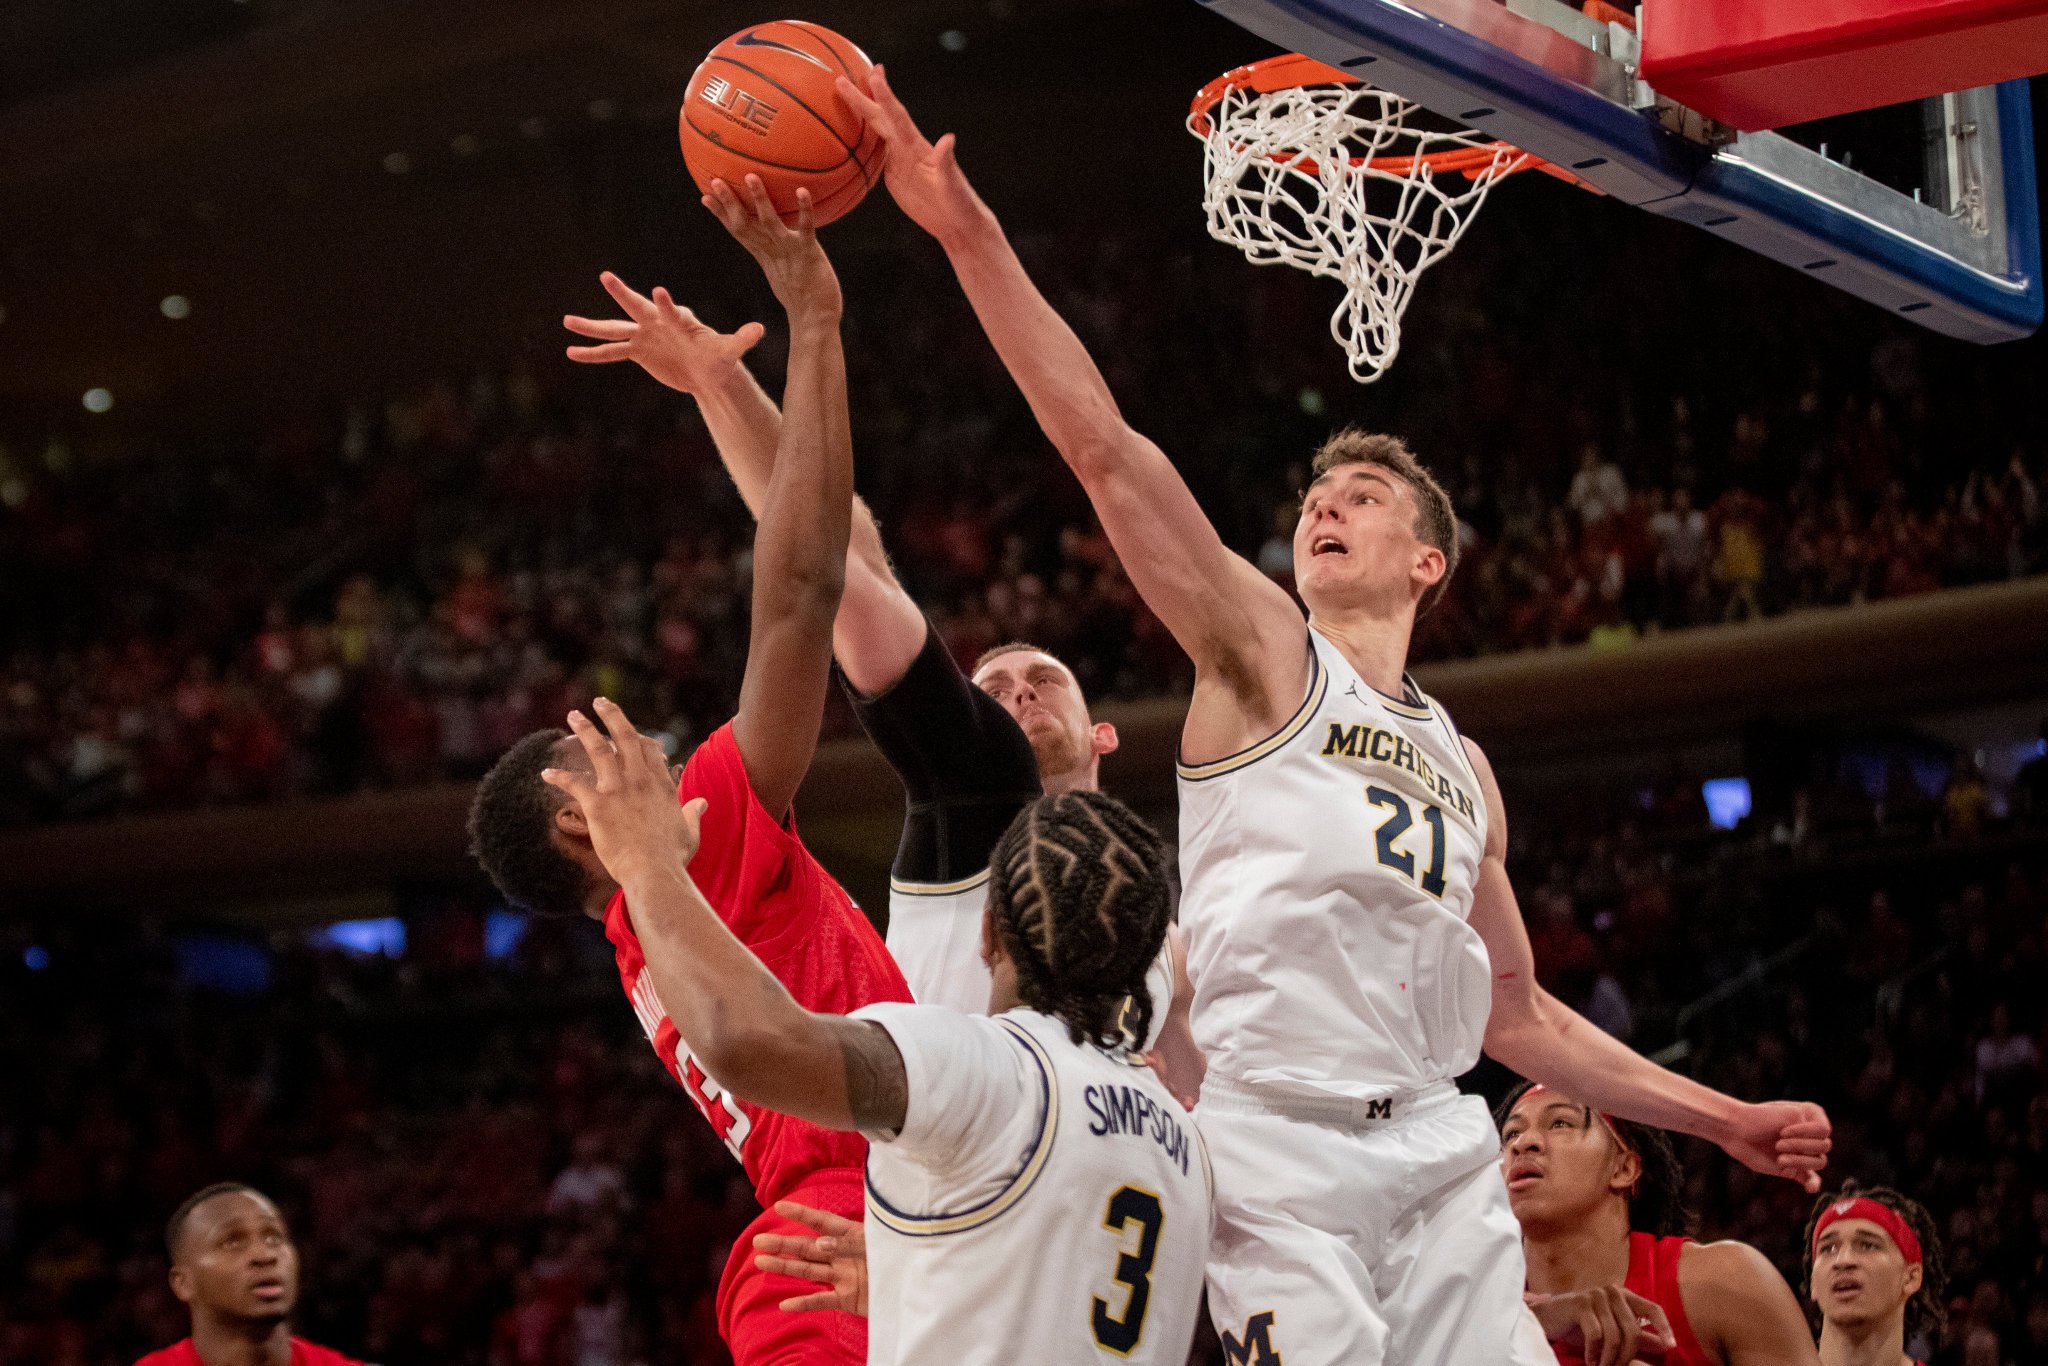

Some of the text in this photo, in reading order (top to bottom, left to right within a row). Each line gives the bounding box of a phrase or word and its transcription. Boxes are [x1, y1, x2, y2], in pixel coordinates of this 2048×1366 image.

[701, 75, 779, 131] ELITE
[1322, 722, 1477, 828] MICHIGAN
[1365, 784, 1447, 898] 21
[1084, 1084, 1189, 1177] SIMPSON
[1366, 1098, 1393, 1119] M
[1089, 1184, 1164, 1358] 3
[1221, 1310, 1282, 1366] M
